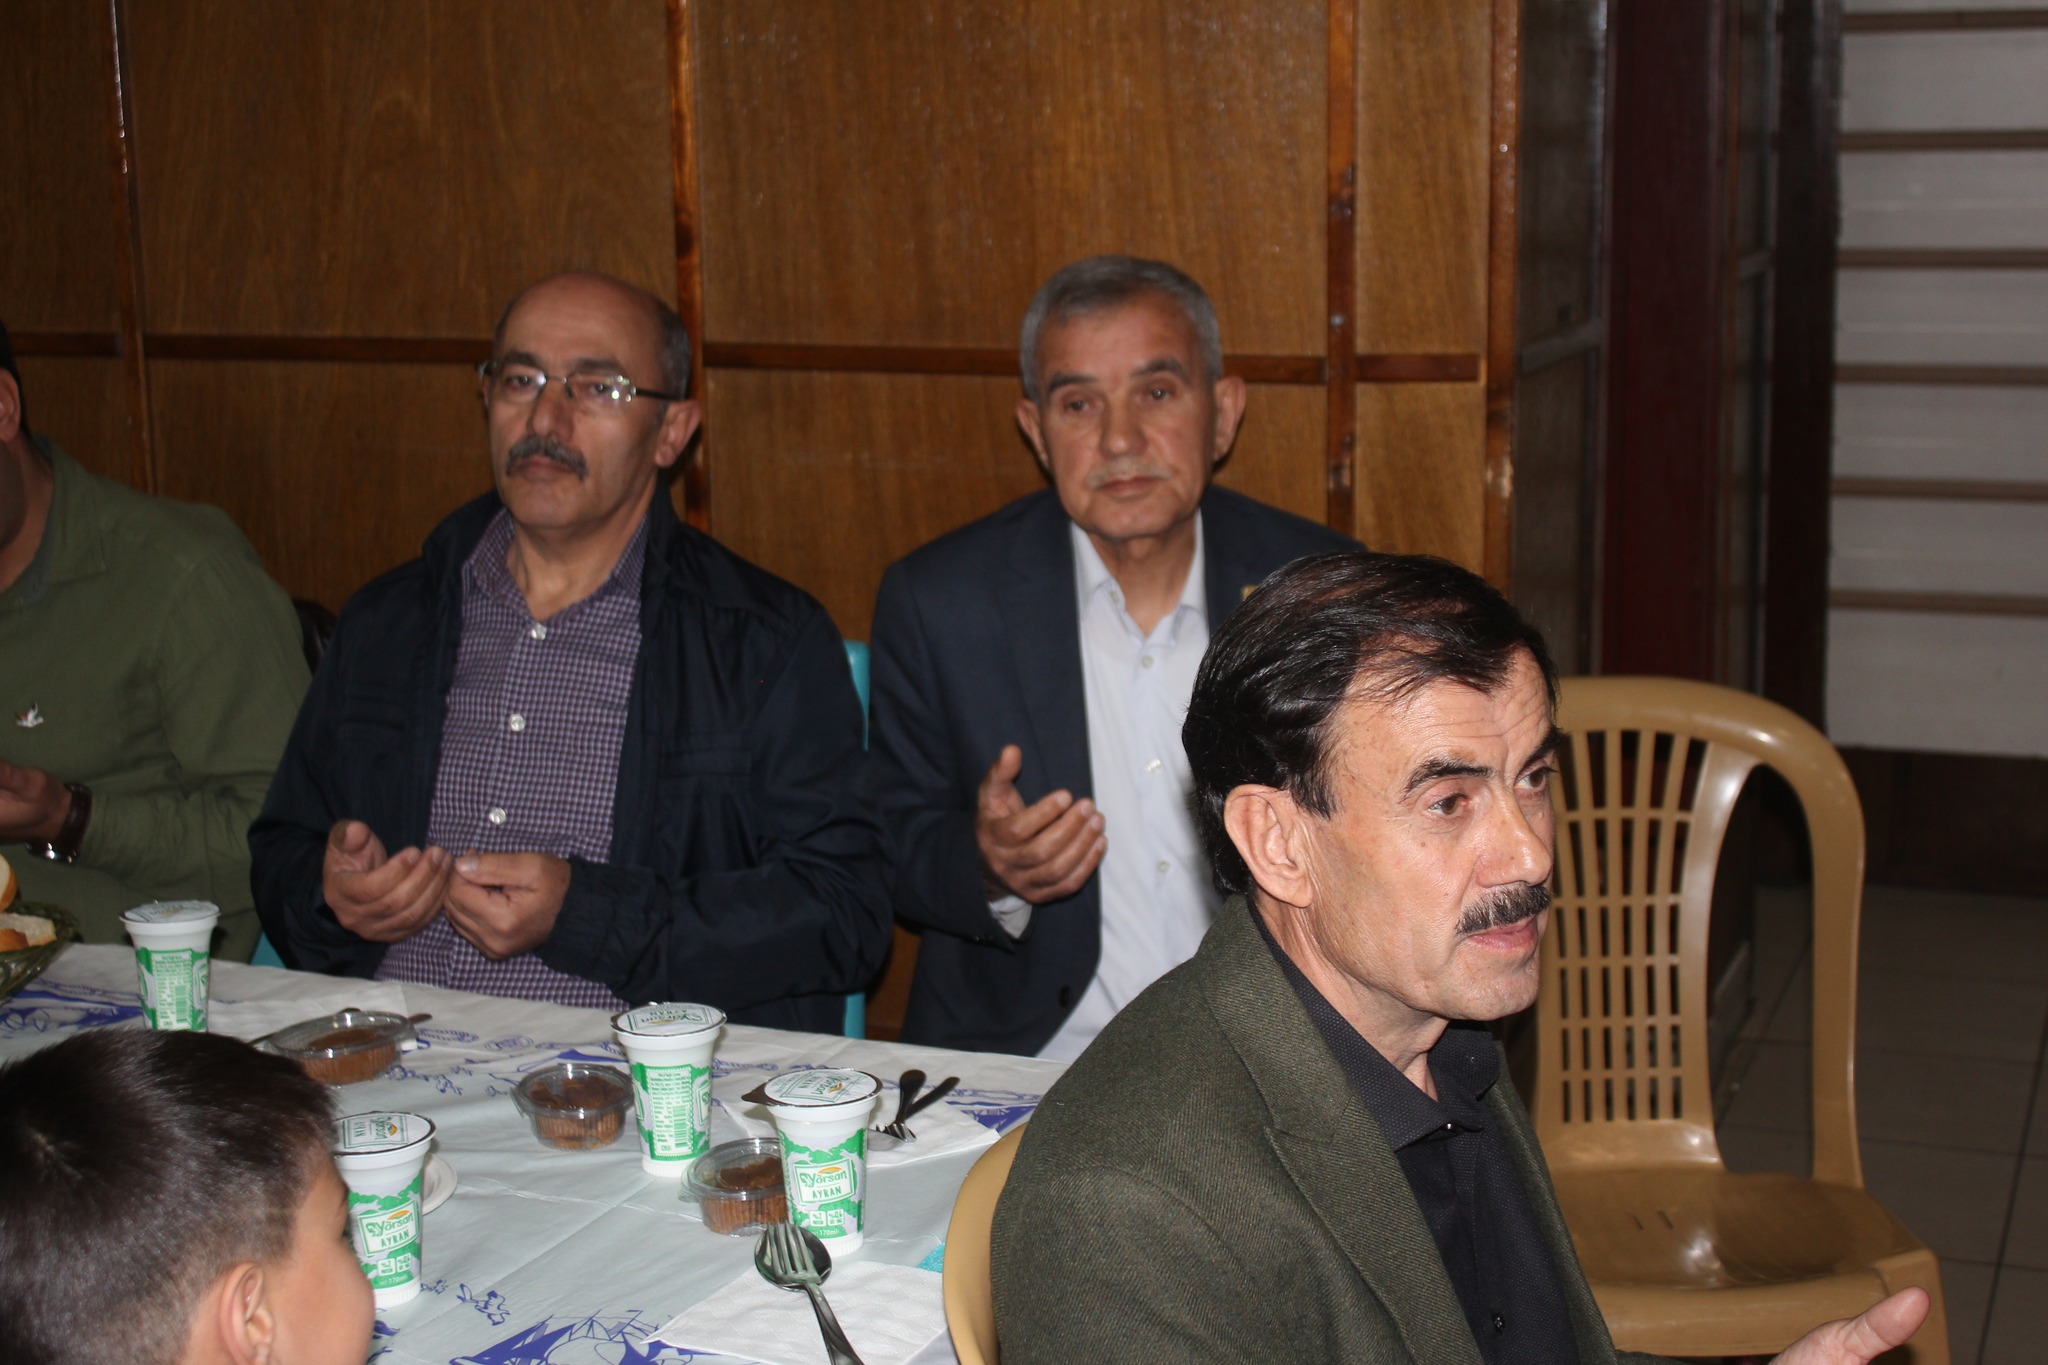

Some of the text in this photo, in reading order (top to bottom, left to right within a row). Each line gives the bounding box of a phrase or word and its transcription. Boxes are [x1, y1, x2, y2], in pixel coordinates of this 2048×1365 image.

[800, 1171, 847, 1187] Yörsan
[812, 1186, 842, 1199] AYRAN
[366, 1213, 413, 1237] Yörsan
[381, 1230, 409, 1247] AYRAN
